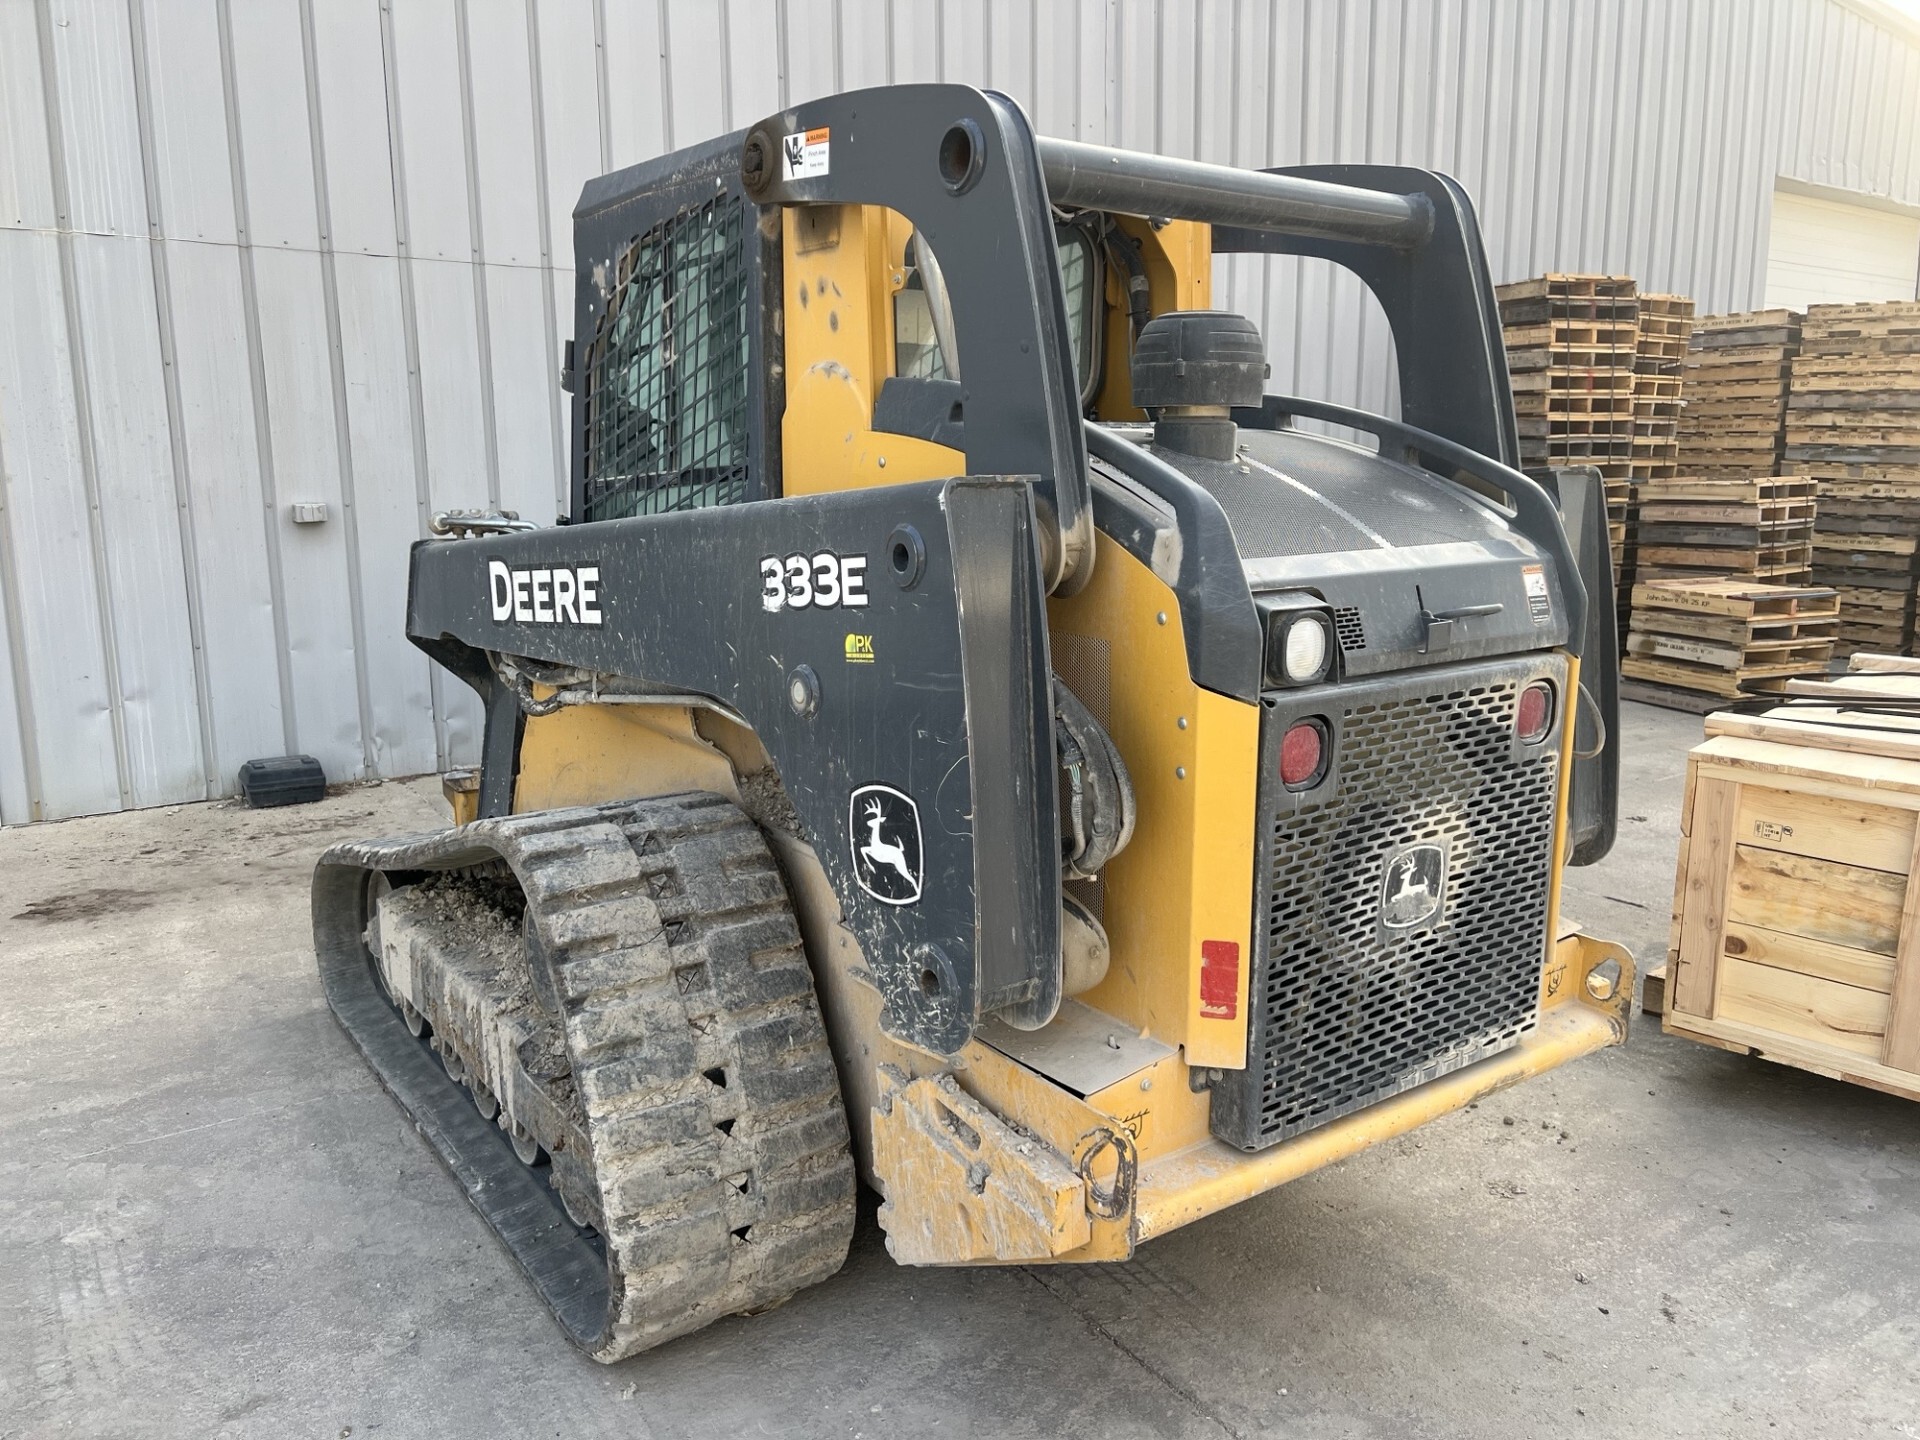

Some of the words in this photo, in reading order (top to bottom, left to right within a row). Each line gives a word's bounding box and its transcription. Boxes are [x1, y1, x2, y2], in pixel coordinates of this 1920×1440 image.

[810, 132, 828, 140] WARNING
[488, 560, 602, 624] DEERE
[760, 553, 869, 612] 333E
